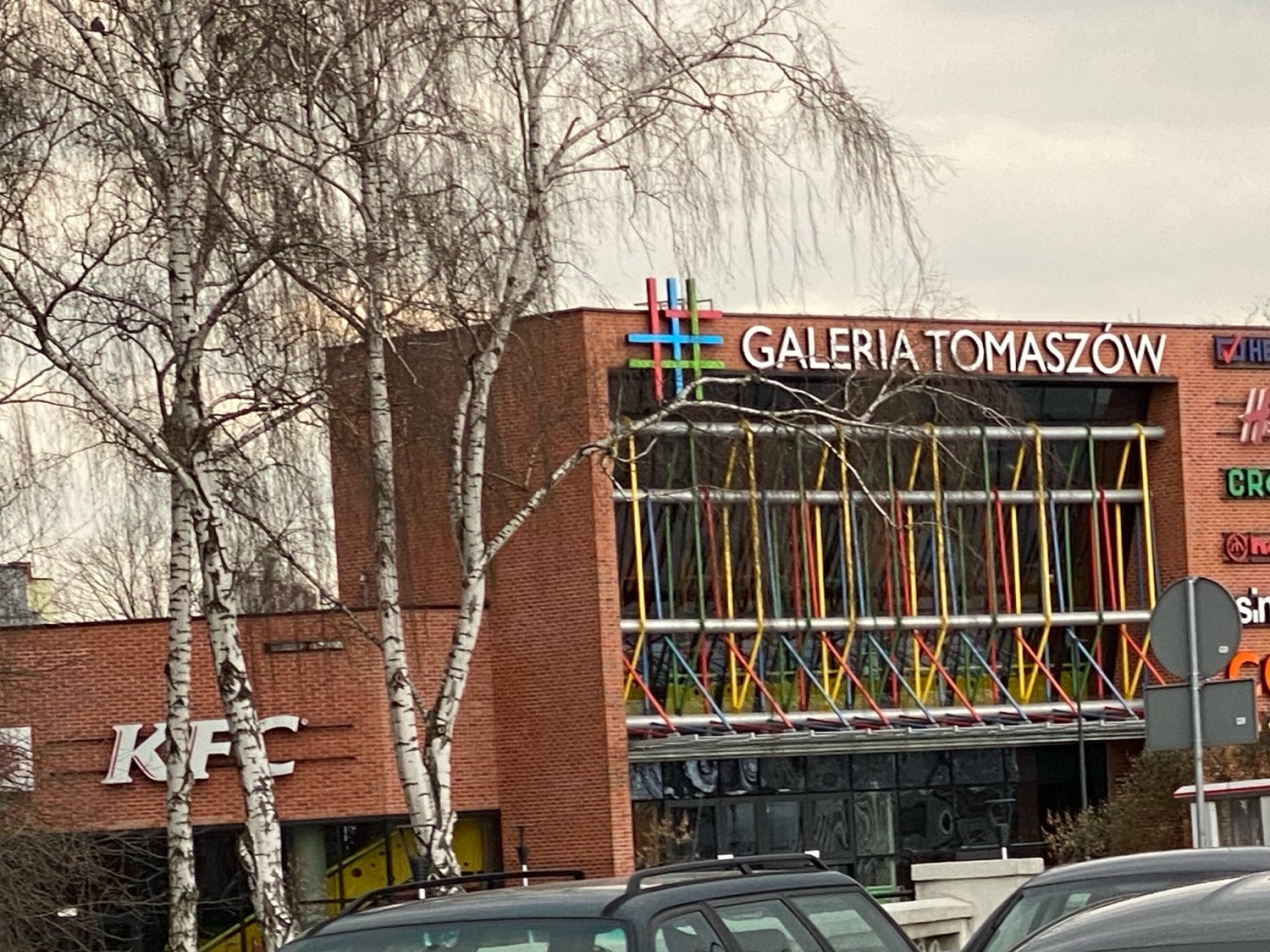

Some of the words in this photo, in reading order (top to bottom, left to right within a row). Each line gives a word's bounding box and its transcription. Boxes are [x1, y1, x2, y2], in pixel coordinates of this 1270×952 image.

[741, 325, 920, 371] GALERIA
[924, 323, 1168, 375] TOMASZÓW
[101, 714, 300, 785] KFC
